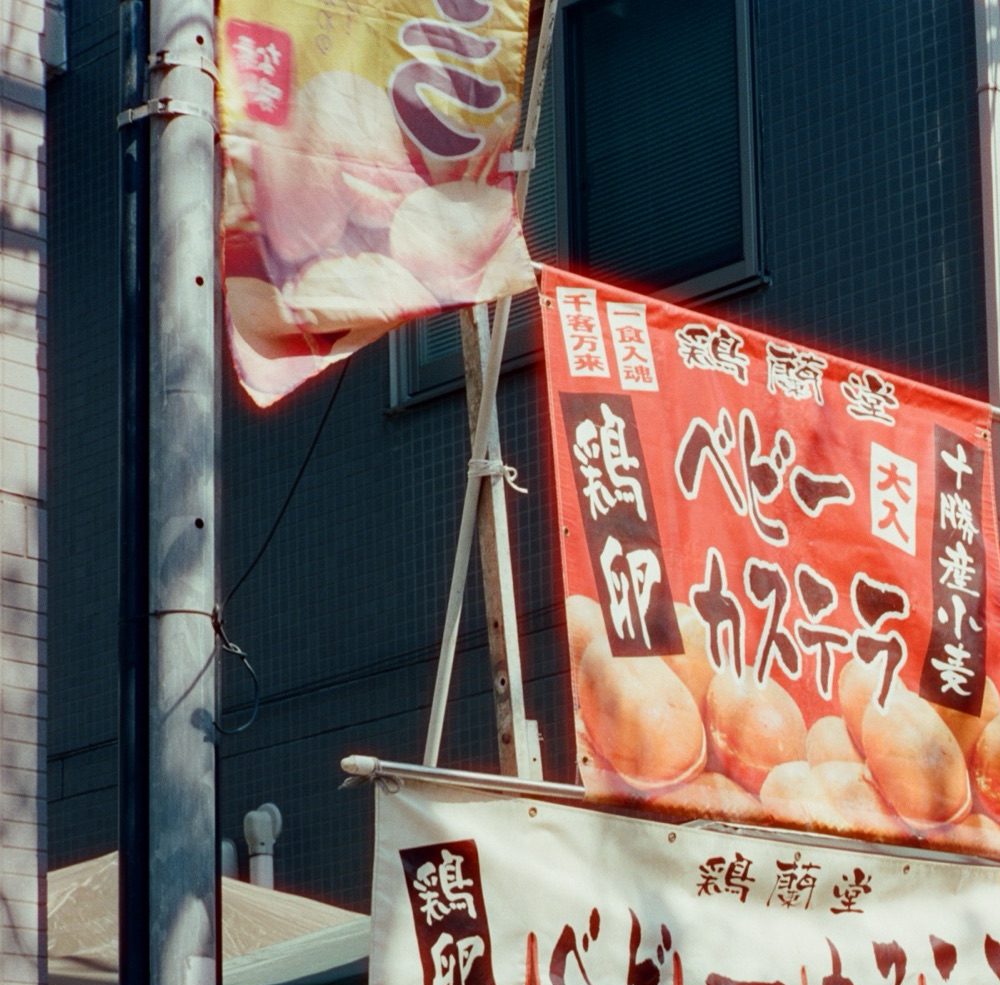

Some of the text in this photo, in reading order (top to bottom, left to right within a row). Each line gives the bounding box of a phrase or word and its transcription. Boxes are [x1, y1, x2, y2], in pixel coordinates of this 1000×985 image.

[563, 294, 604, 371] 千客万来
[613, 311, 653, 383] 一食入魂
[675, 324, 899, 427] 鶏蘭堂
[574, 402, 662, 650] 鶏卵
[675, 408, 855, 547] ベビー
[877, 462, 913, 543] 大入
[930, 443, 984, 697] 十勝産小麦
[689, 546, 910, 715] カステラ
[696, 852, 872, 915] 鶏蘭堂
